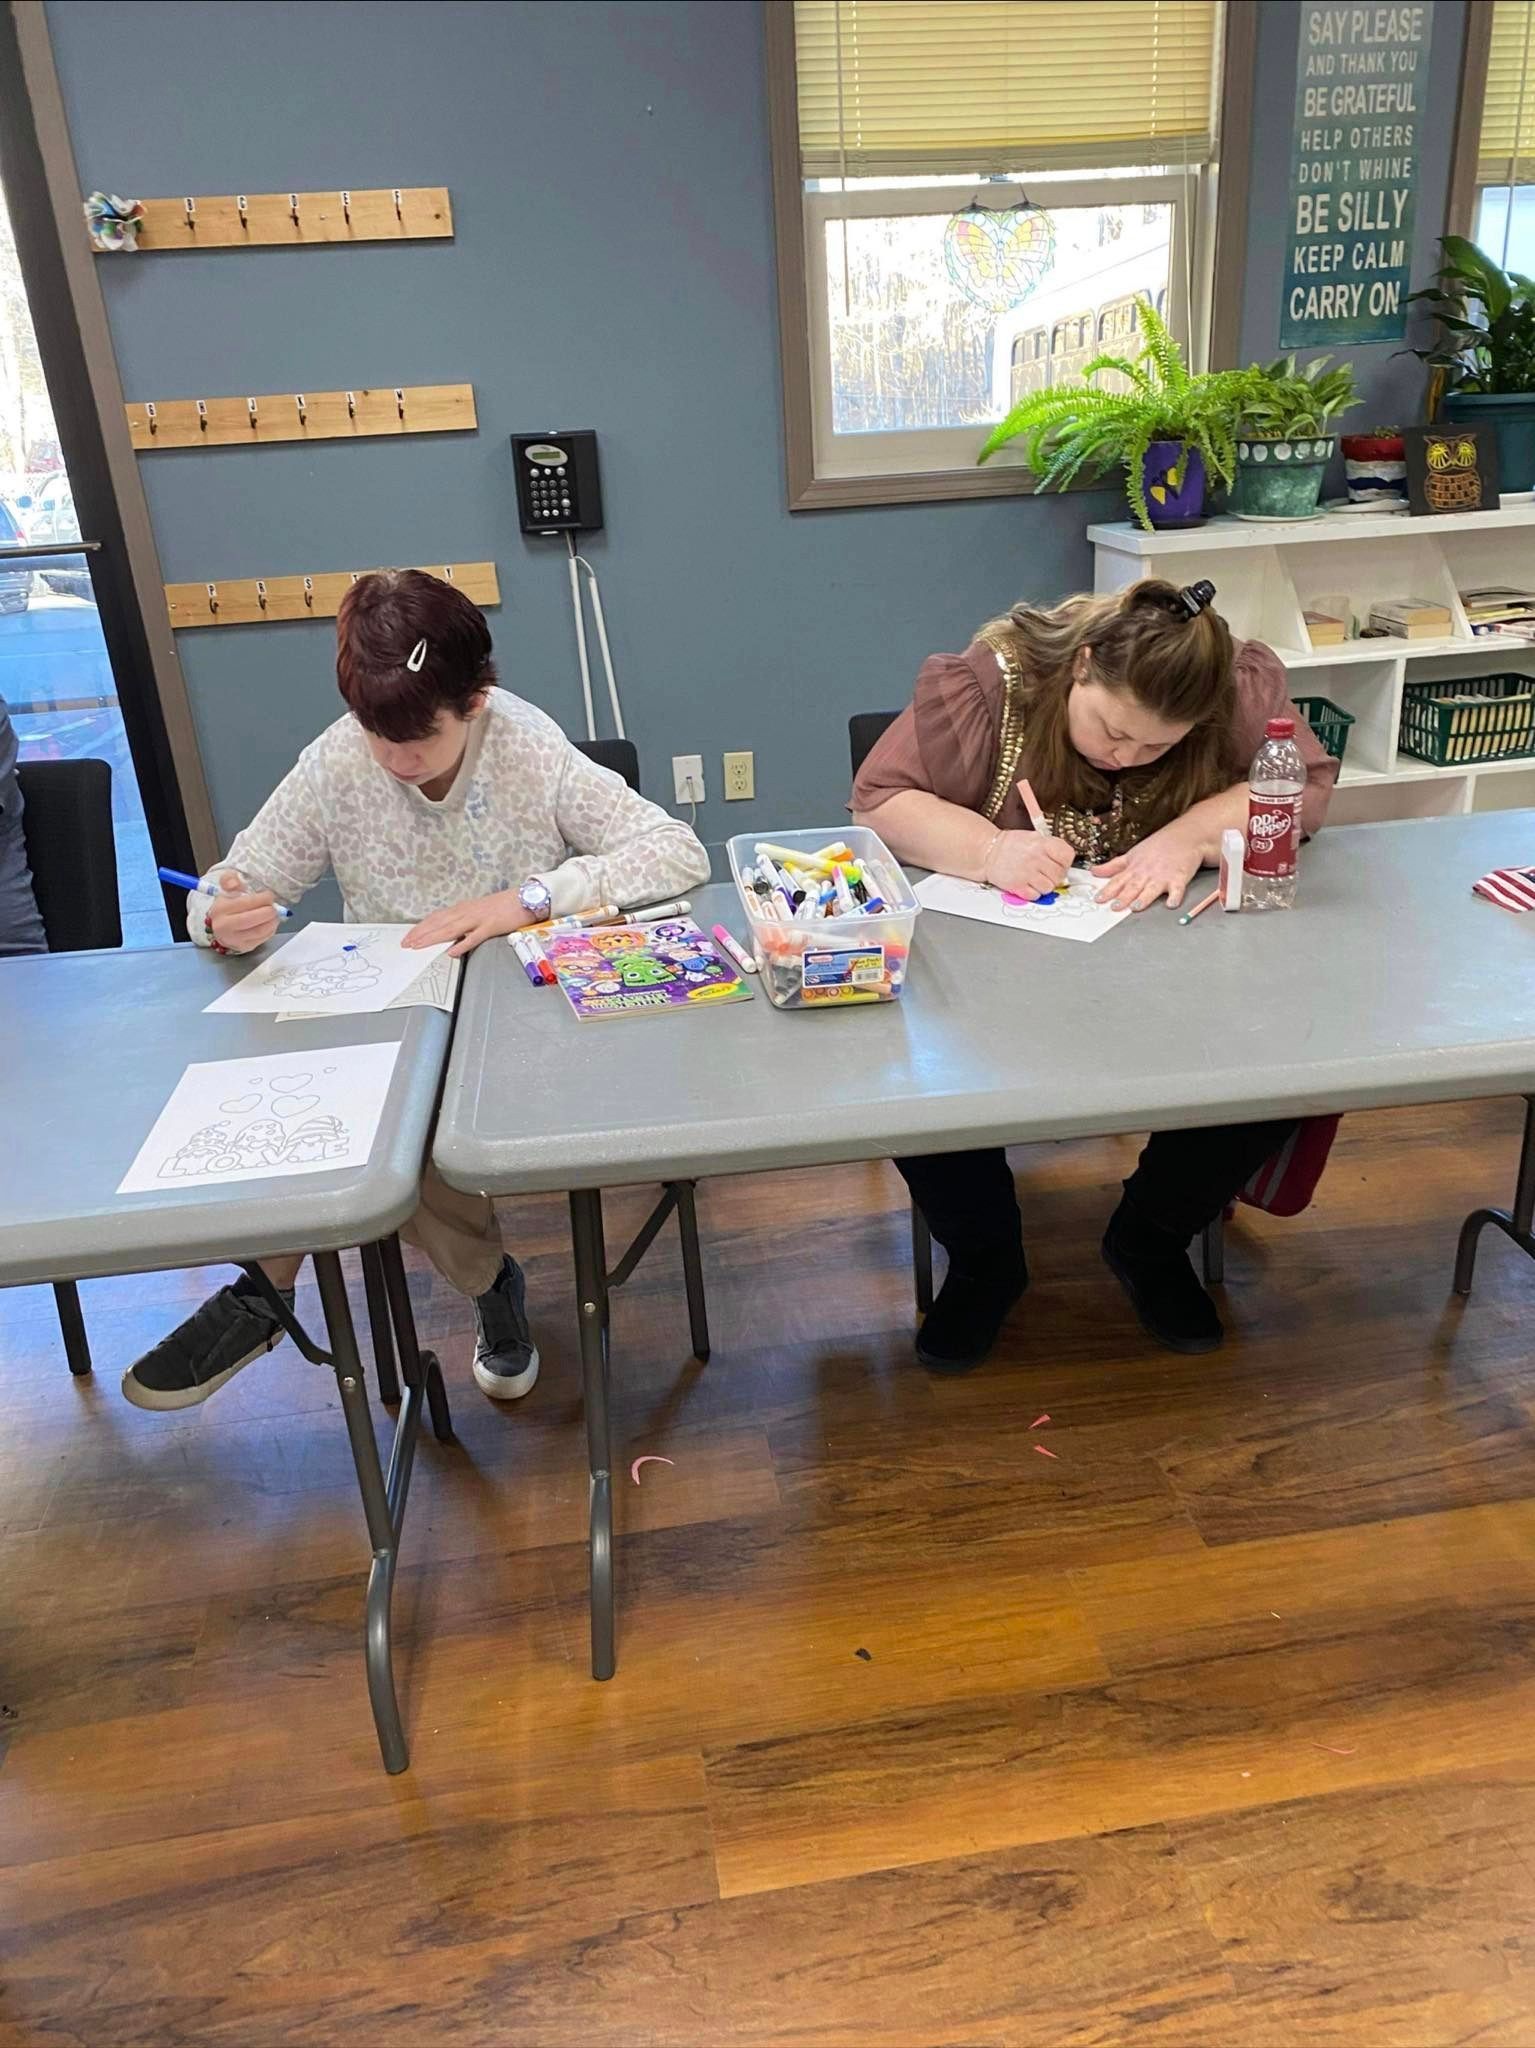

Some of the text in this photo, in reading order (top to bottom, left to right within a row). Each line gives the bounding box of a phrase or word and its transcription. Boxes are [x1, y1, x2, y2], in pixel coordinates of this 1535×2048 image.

[1308, 7, 1424, 45] SAY PLEASE
[1306, 50, 1417, 76] AND THANK YOU
[1303, 82, 1416, 117] BE GRATEFUL
[1301, 124, 1413, 151] HELP OTHERS
[1299, 157, 1412, 183] DON'T WHINE
[1296, 189, 1408, 235] BE SILLY
[1293, 240, 1404, 274] KEEP CALM
[1289, 281, 1400, 321] CARRY ON
[1250, 815, 1289, 837] Pepper
[1261, 813, 1280, 825] Dr
[157, 1136, 350, 1178] LOVE
